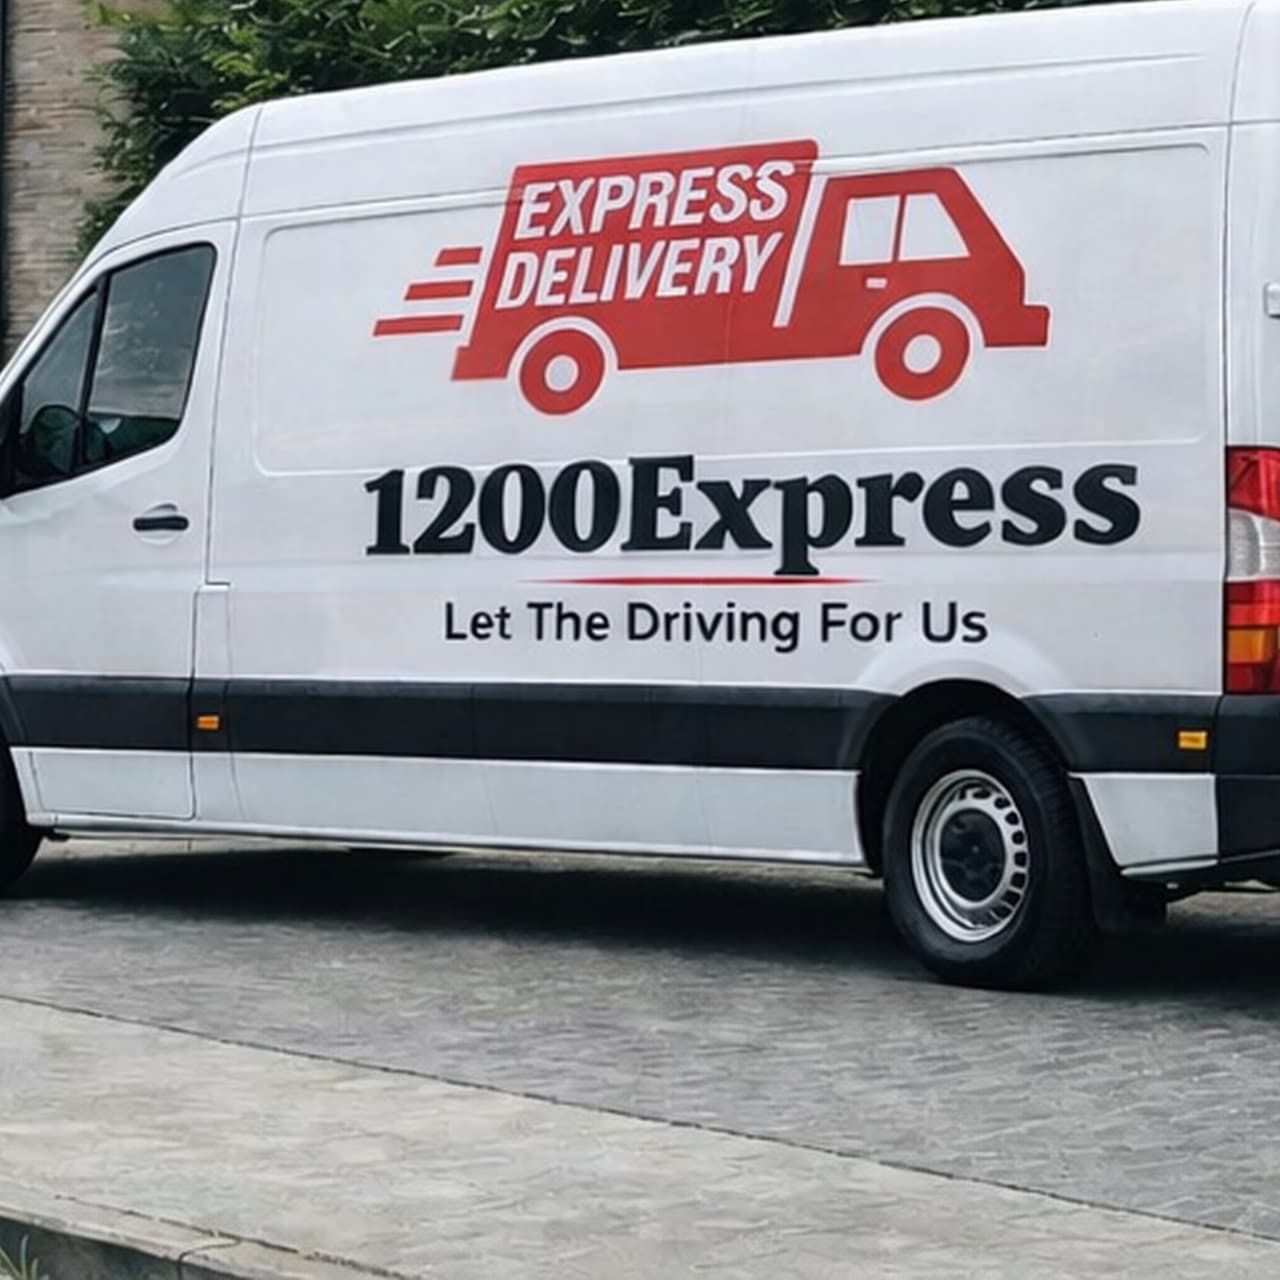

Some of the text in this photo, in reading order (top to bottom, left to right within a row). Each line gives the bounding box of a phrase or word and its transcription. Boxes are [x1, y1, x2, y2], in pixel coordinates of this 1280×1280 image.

[514, 160, 796, 240] EXPRESS
[494, 231, 784, 310] DELIVERY
[365, 455, 1142, 577] 1200Express
[444, 600, 988, 654] Let The Driving For Us
